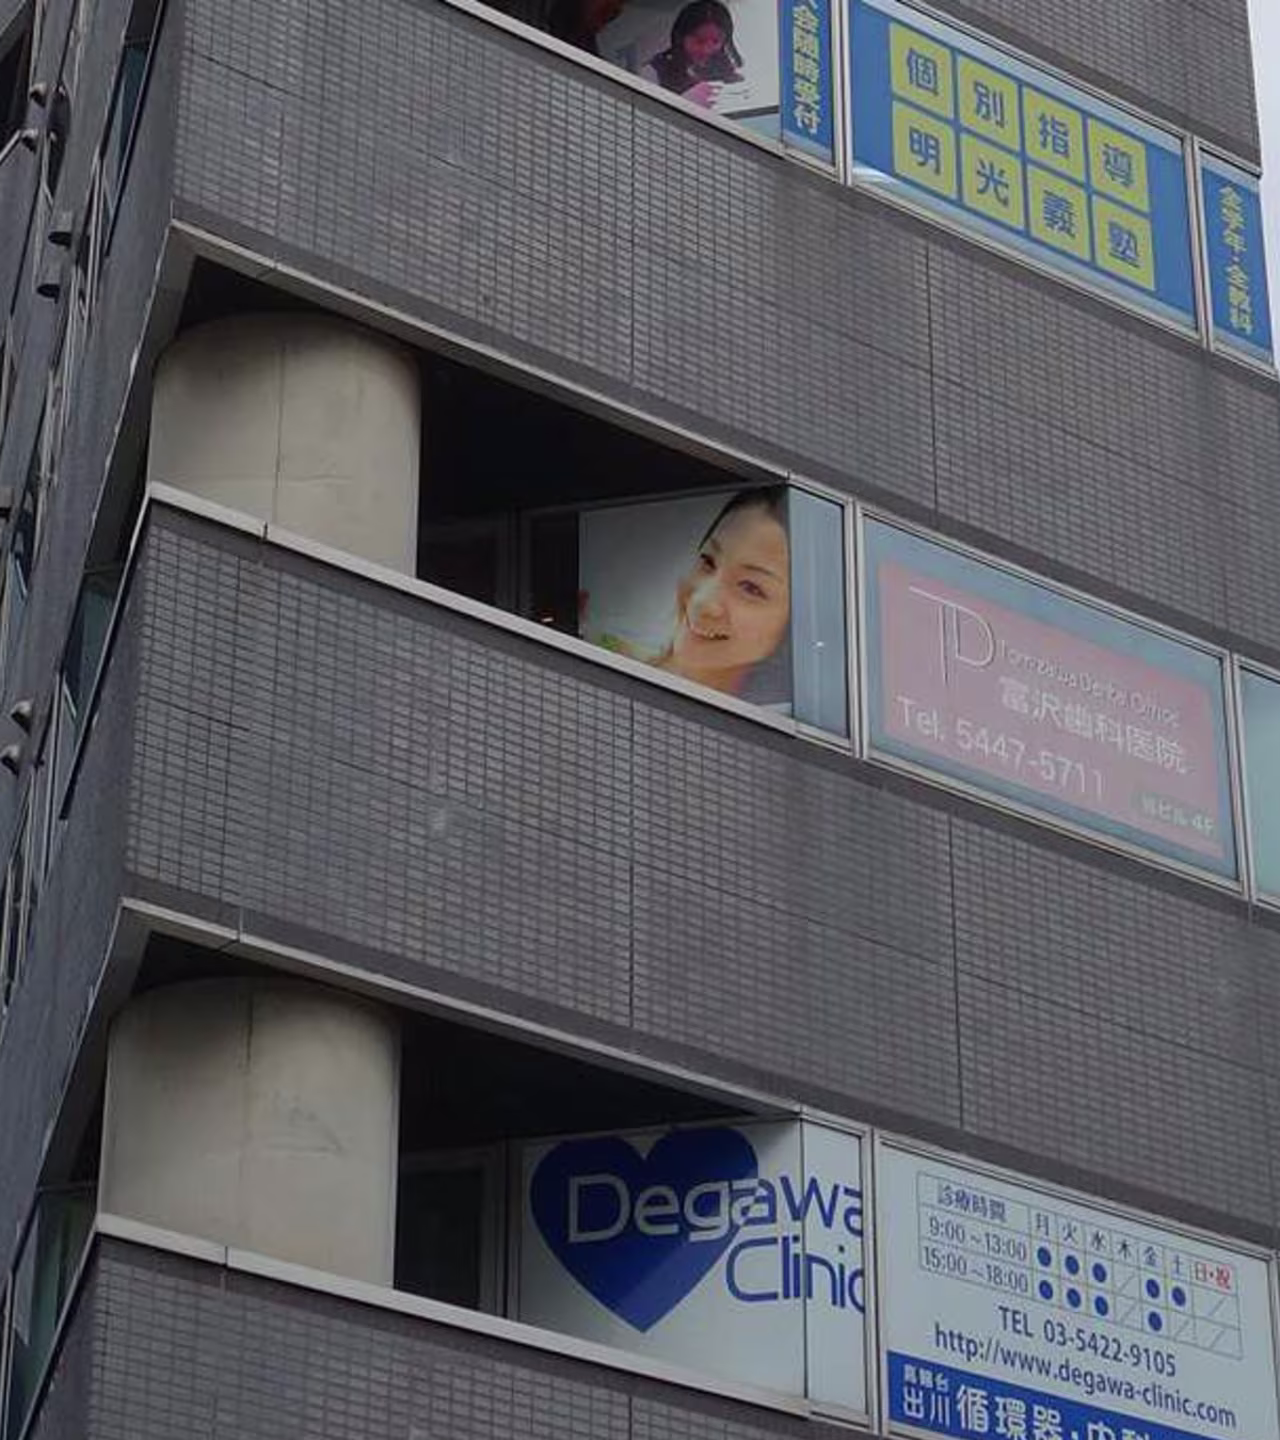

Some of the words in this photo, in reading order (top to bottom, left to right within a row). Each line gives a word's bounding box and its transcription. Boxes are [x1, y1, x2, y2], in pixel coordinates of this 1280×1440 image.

[906, 46, 1135, 188] 個別指導
[910, 129, 1140, 268] 明光義塾
[957, 721, 1106, 799] 5447-5711
[726, 1234, 866, 1313] Clinic
[1036, 1212, 1050, 1236] 月
[1062, 1223, 1077, 1244] 火
[1092, 1230, 1106, 1250] 水
[1143, 1245, 1157, 1267] 金
[935, 1323, 1237, 1429] http://www.degawa-clinic.com
[999, 1305, 1034, 1338] TEL
[1044, 1320, 1176, 1377] 03-5422-9105
